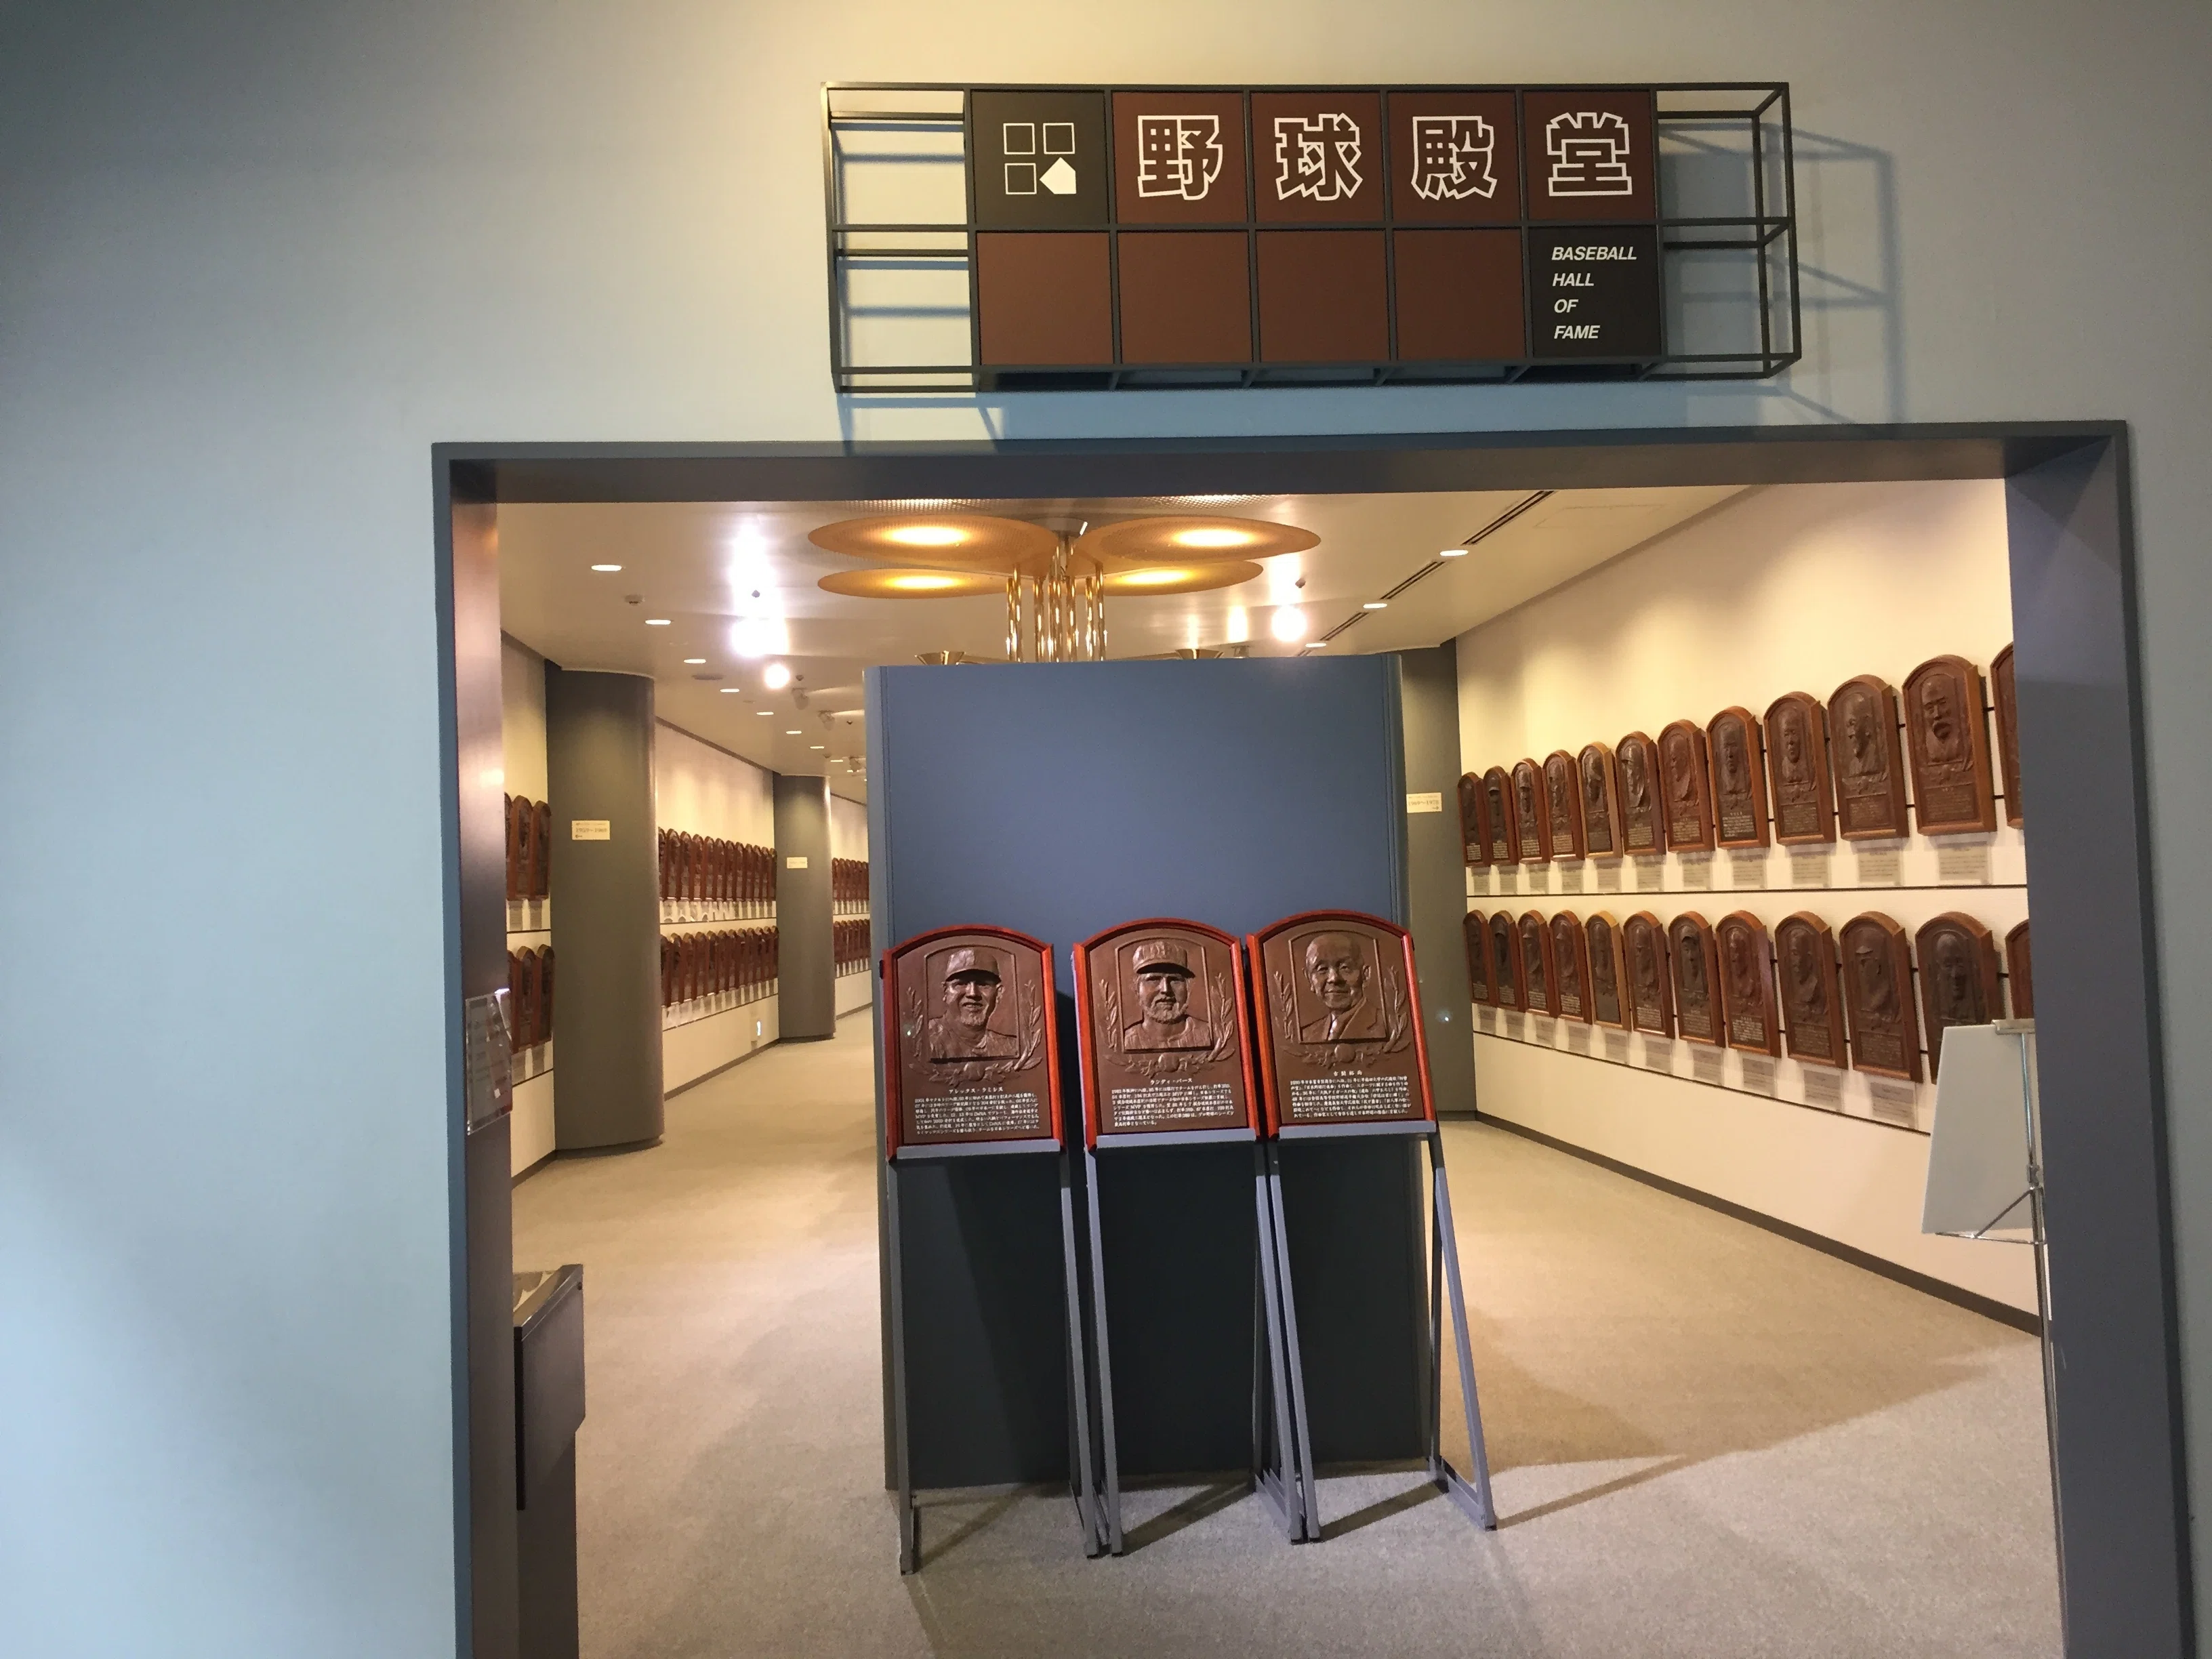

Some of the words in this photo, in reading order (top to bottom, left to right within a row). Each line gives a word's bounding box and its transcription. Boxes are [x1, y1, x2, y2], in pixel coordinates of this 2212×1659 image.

[1138, 112, 1633, 201] 野球殿堂
[1551, 246, 1637, 261] BASEBALL
[1552, 272, 1595, 287] HALL
[1554, 299, 1579, 313] OF
[1554, 325, 1601, 340] FAME
